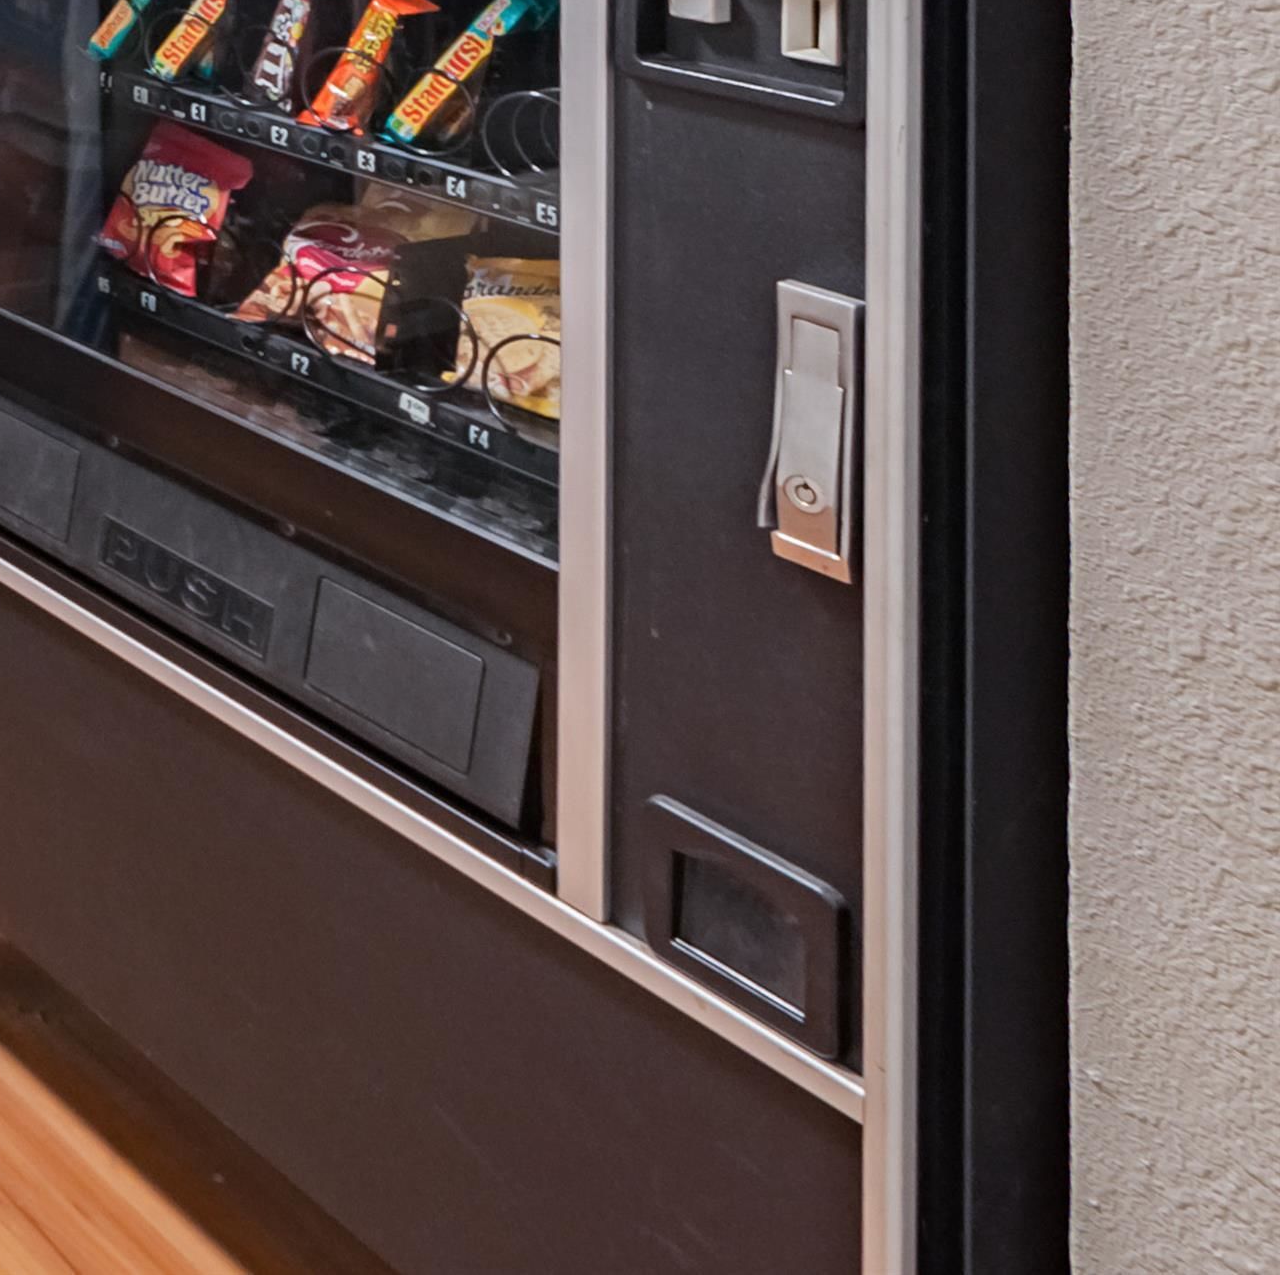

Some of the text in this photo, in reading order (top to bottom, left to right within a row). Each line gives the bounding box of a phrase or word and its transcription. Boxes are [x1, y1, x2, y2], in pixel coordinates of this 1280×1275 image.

[190, 102, 206, 122] E1
[270, 125, 288, 146] E2
[357, 150, 376, 172] E3
[133, 159, 209, 192] Nutter
[446, 176, 466, 198] E4
[132, 181, 209, 213] Butter
[536, 202, 558, 226] E5
[291, 353, 310, 375] F2
[469, 424, 489, 449] F4
[104, 525, 265, 647] PUSH
